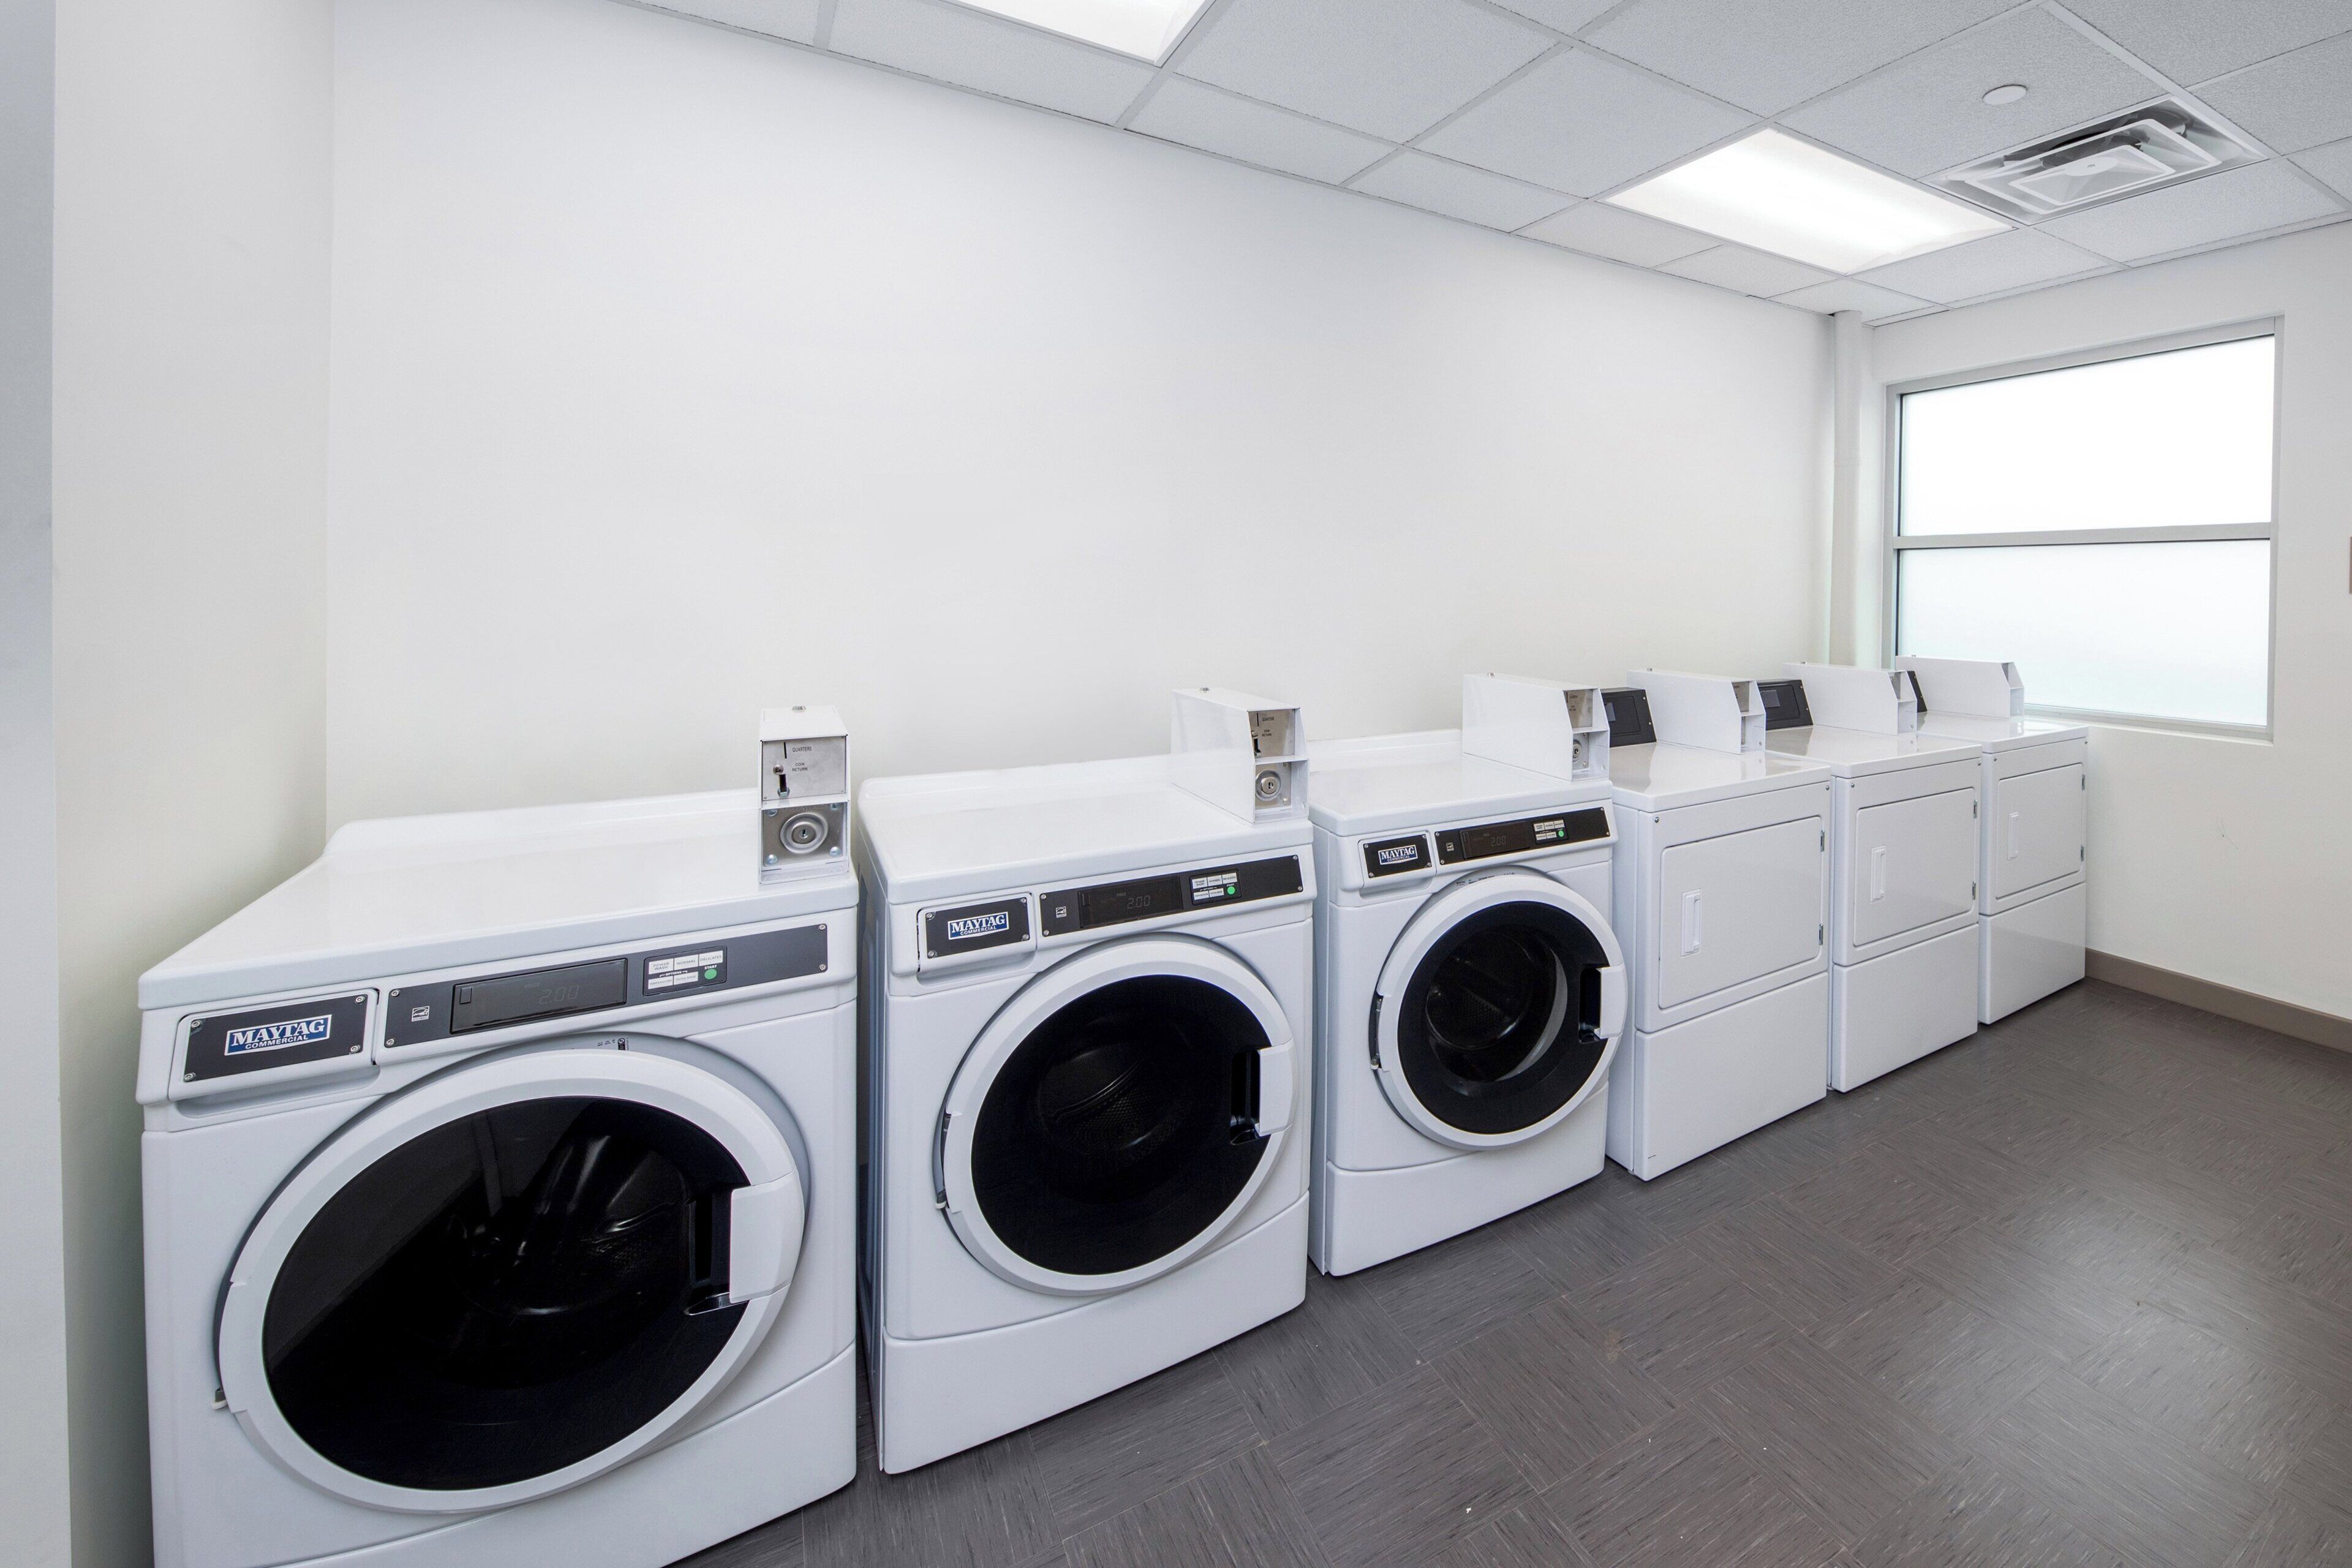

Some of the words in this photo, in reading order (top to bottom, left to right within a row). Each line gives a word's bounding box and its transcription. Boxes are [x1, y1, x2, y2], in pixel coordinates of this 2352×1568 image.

[1381, 847, 1415, 860] MAYTAG
[1127, 895, 1150, 909] 2.00
[951, 914, 1005, 933] MAYTAG
[960, 926, 997, 935] COMMERCIAL
[538, 985, 579, 1004] 2.00
[231, 1019, 325, 1047] MAYTAG
[245, 1036, 309, 1049] COMMERCIAL
